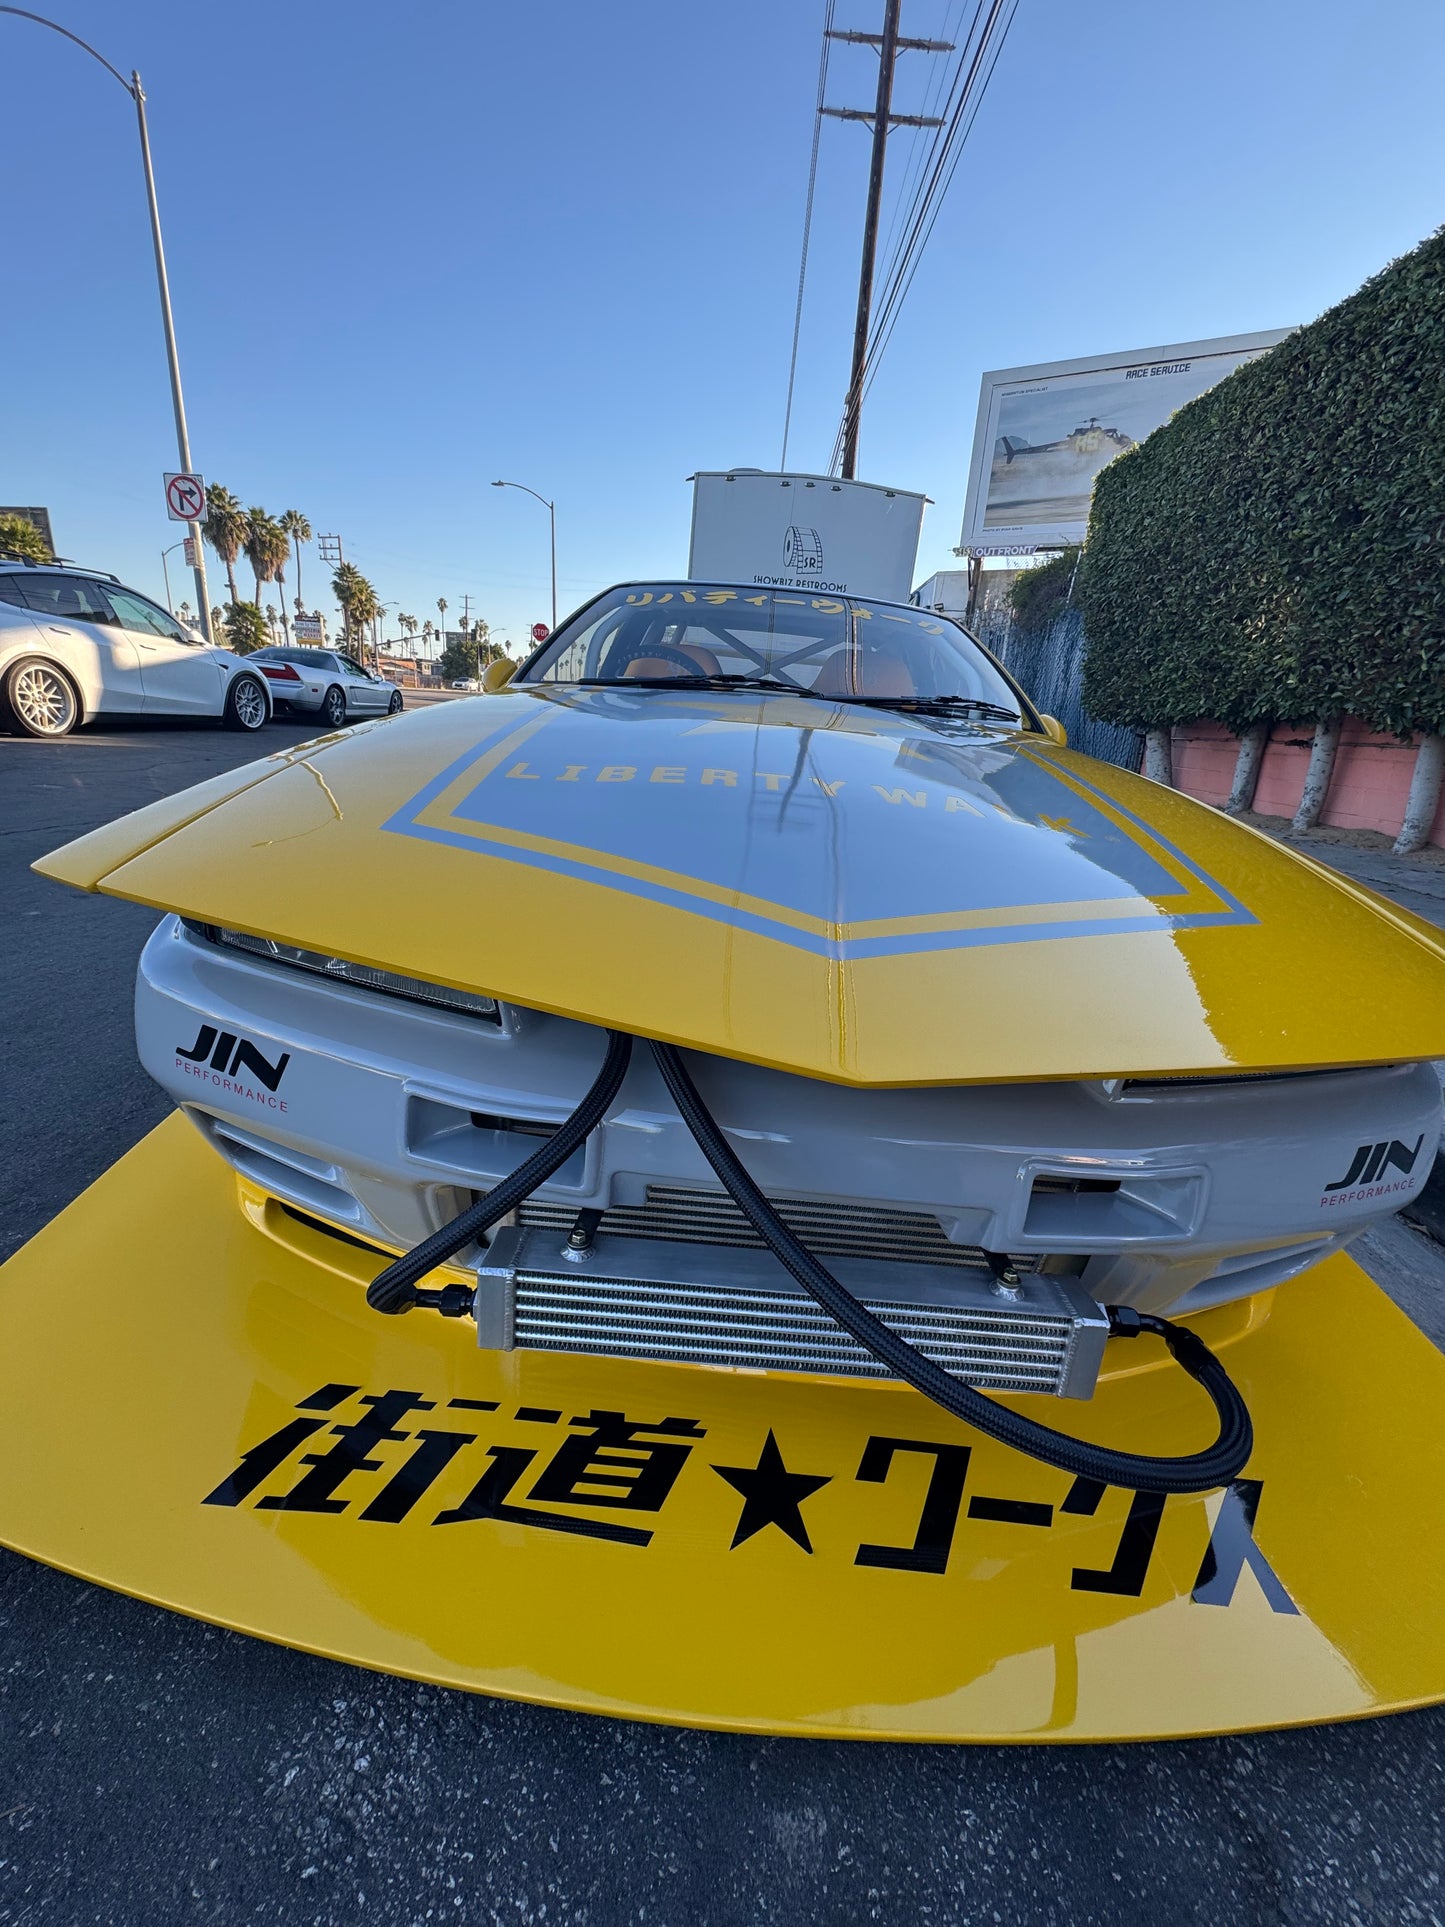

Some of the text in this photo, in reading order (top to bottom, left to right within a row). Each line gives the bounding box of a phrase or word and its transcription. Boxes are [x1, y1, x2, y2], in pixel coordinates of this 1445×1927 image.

[1125, 363, 1191, 380] RACE SERVICE
[803, 557, 816, 568] SR
[975, 545, 1035, 556] OUTFRONT
[753, 575, 848, 593] SHOWBIZ RESTROOMS
[504, 762, 1093, 839] LIBERTY WAK
[176, 1024, 290, 1092] JIN
[175, 1058, 289, 1113] PERFORMANCE
[1324, 1133, 1425, 1192] JIN
[1320, 1178, 1415, 1208] PERFORMANCE
